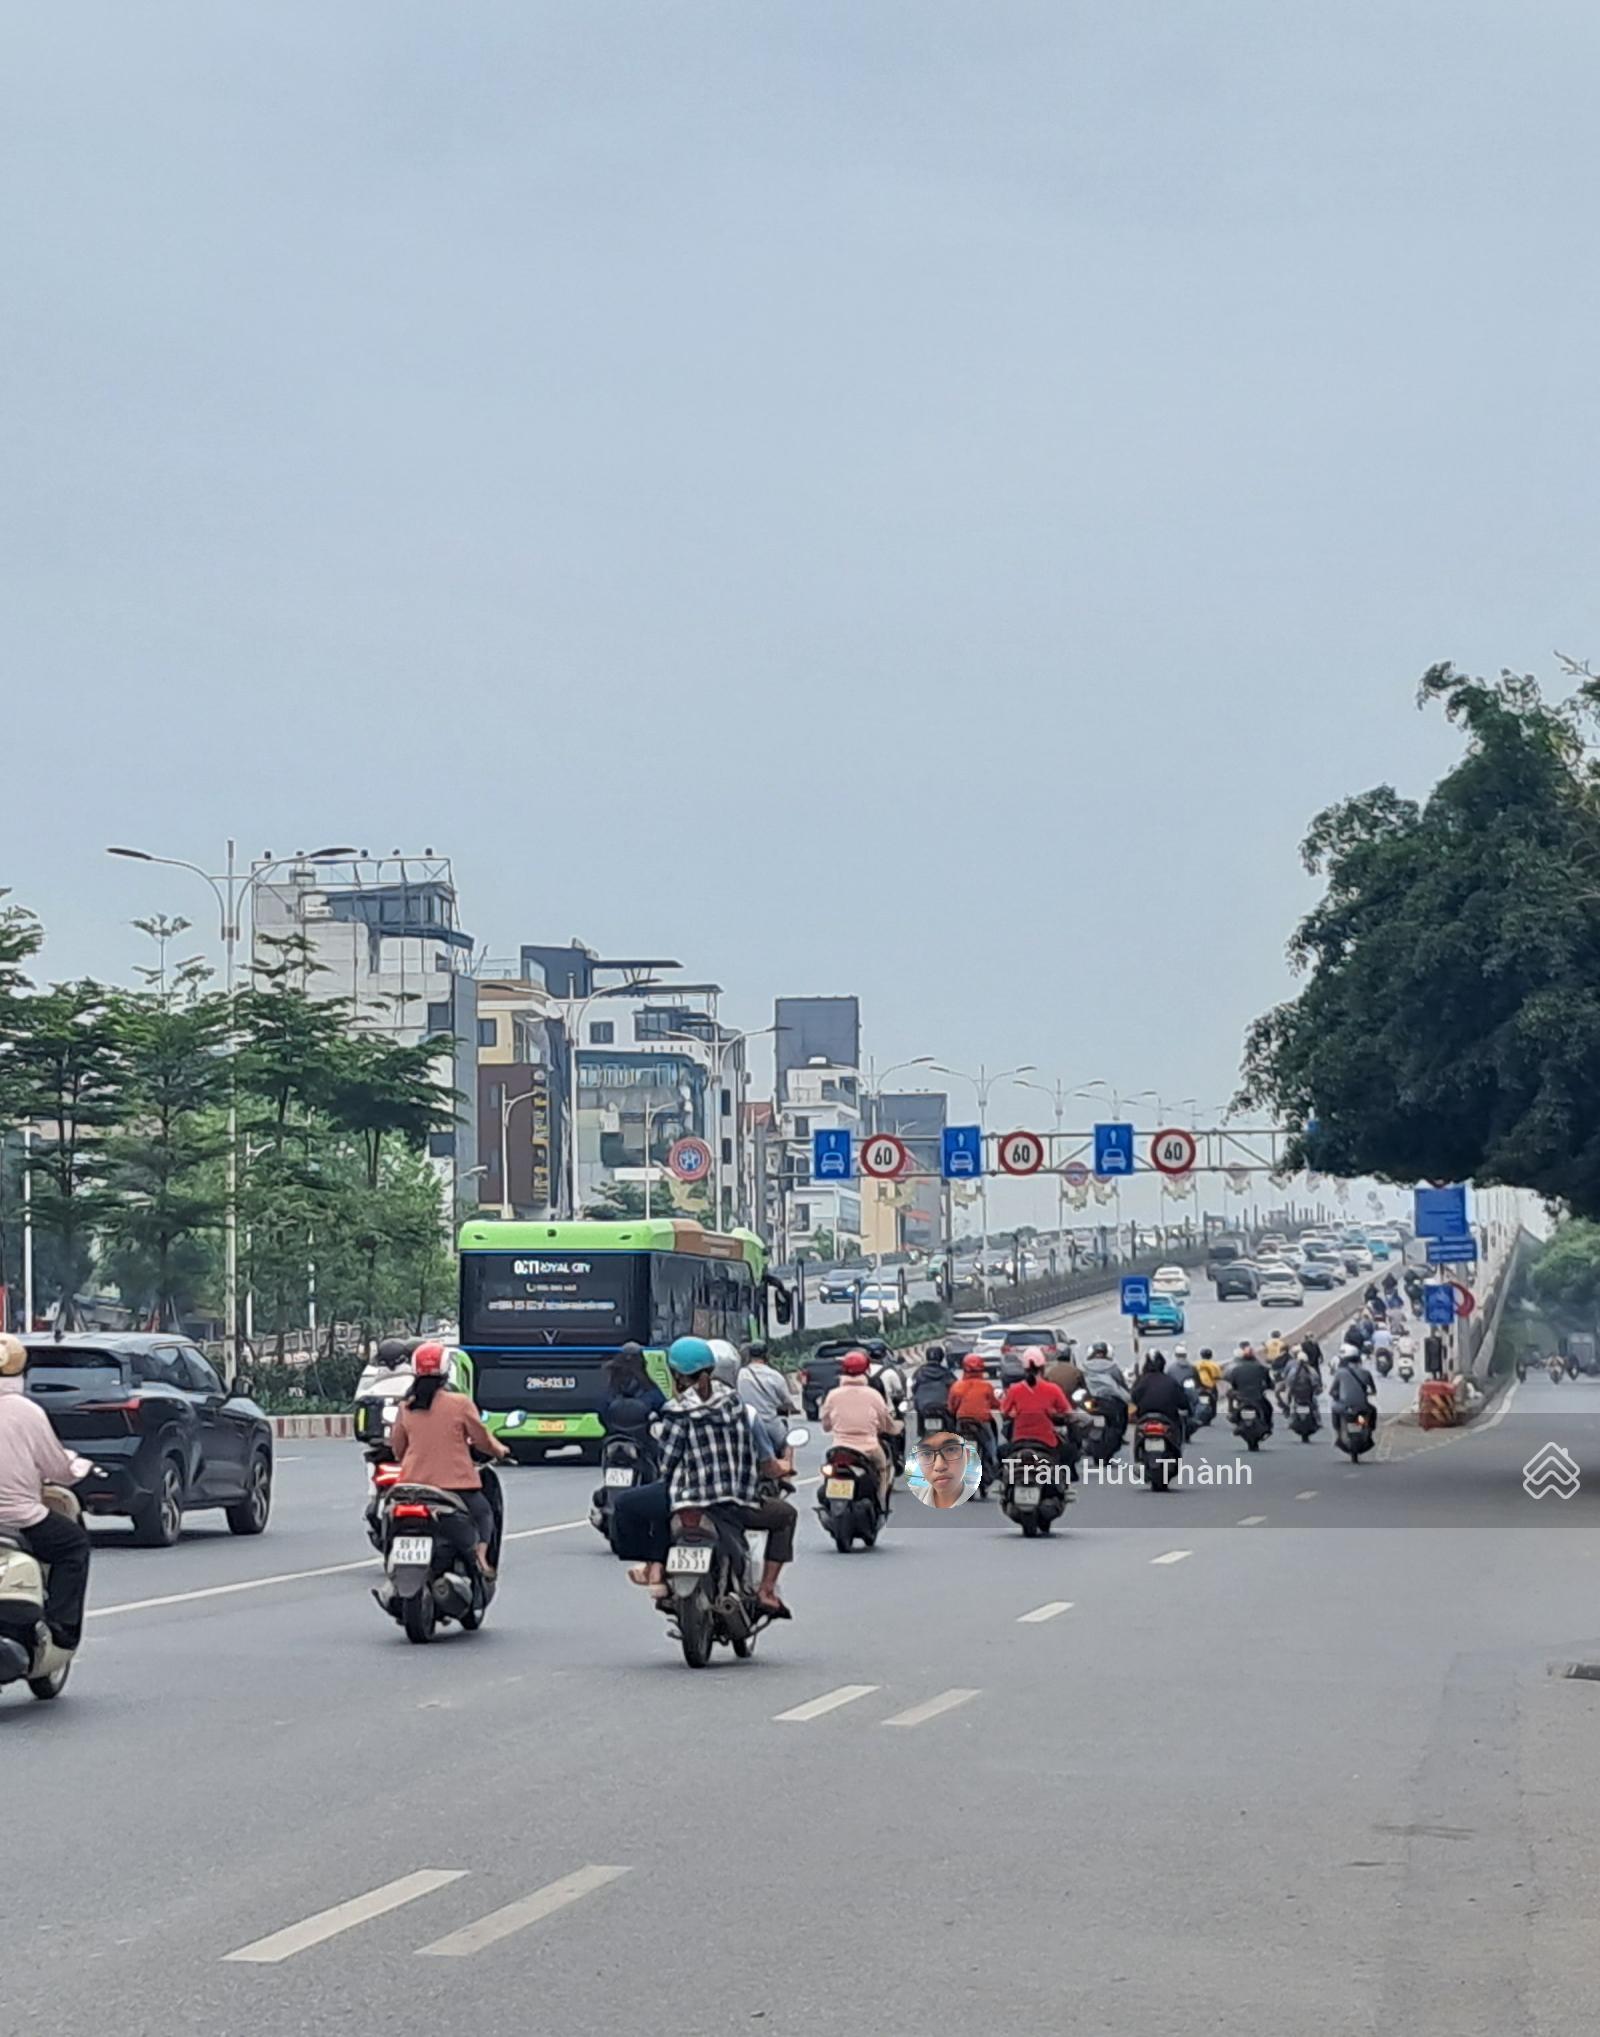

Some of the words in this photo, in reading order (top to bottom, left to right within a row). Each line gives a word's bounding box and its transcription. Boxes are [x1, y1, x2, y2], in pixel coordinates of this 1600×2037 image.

[874, 1147, 892, 1166] 60
[1012, 1144, 1030, 1164] 60
[1164, 1142, 1183, 1161] 60
